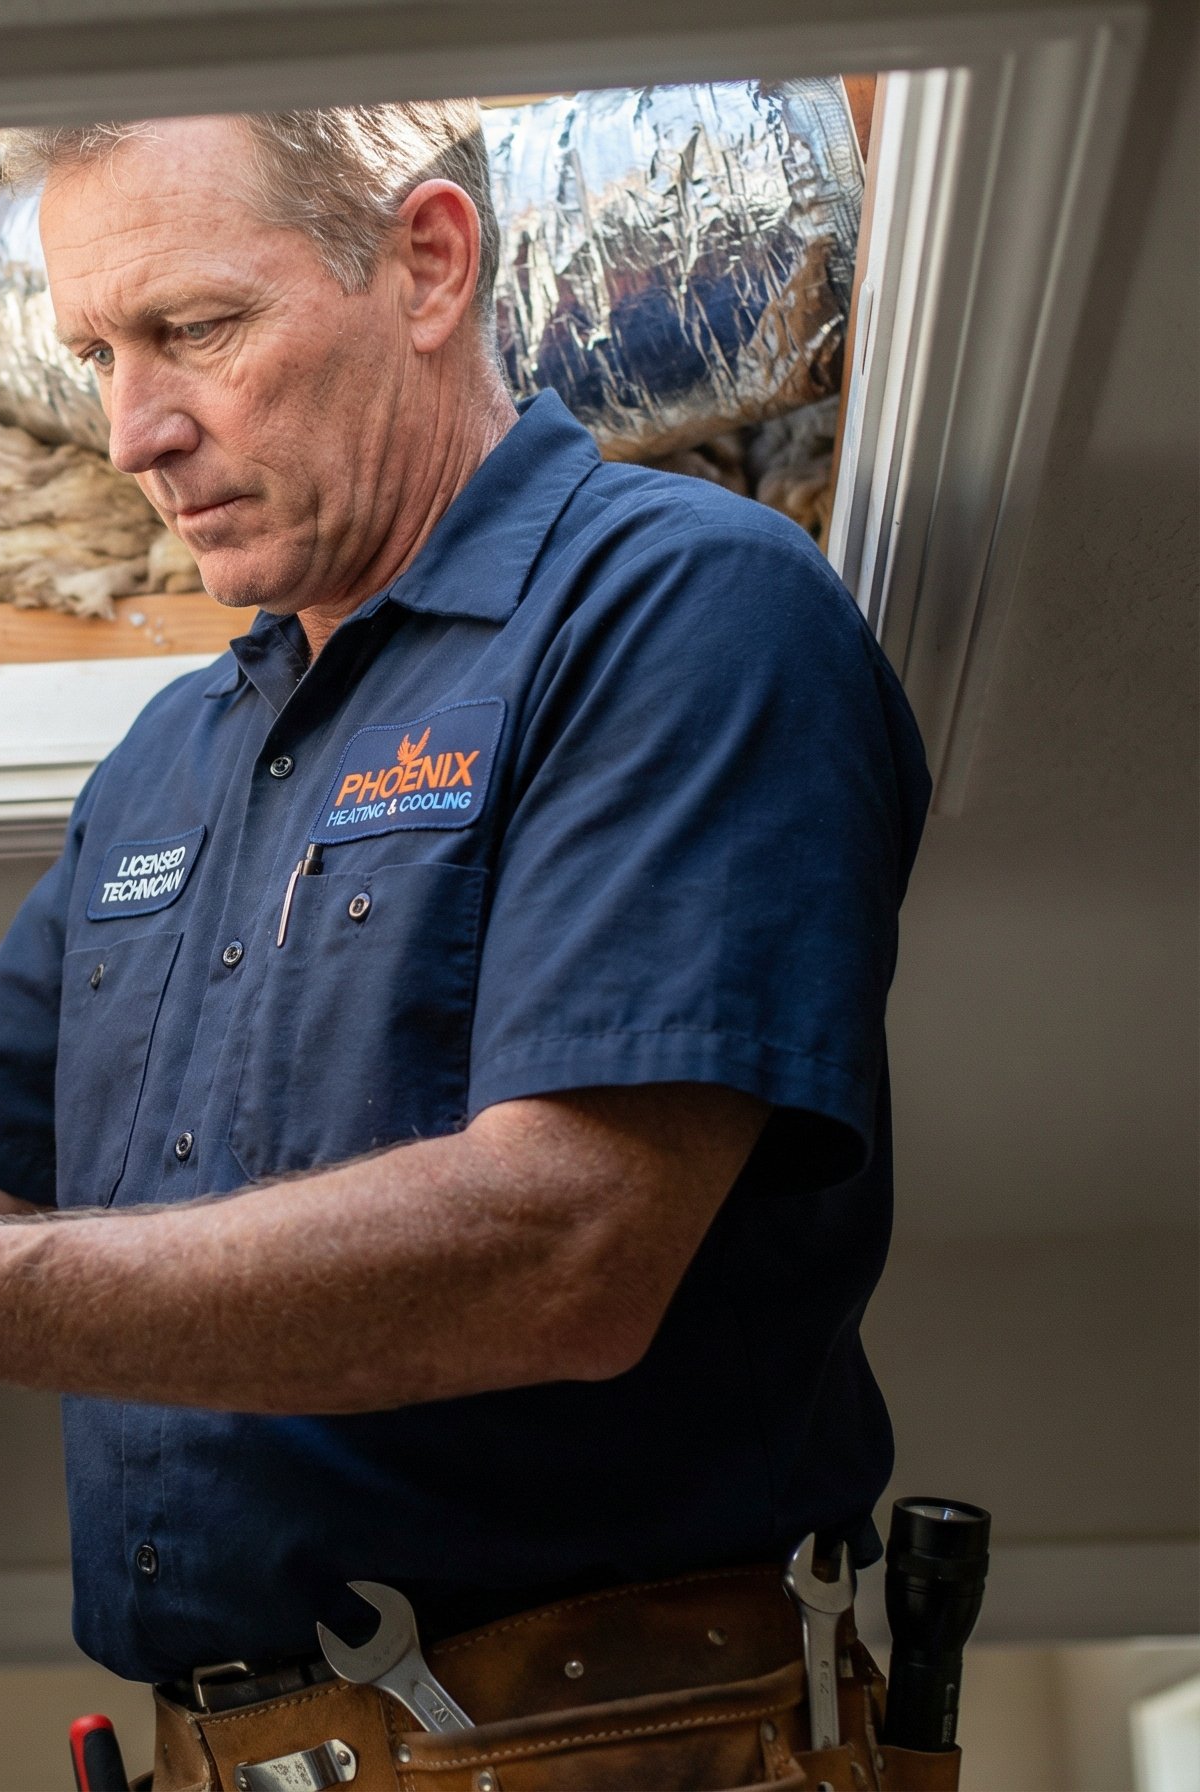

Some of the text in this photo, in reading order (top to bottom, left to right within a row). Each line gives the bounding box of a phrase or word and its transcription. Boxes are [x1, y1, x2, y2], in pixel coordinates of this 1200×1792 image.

[335, 750, 480, 808] PHOENIX
[326, 791, 472, 827] HEATING & COOLING
[117, 846, 186, 878] LICENSED
[101, 868, 185, 904] TECHNICIAN
